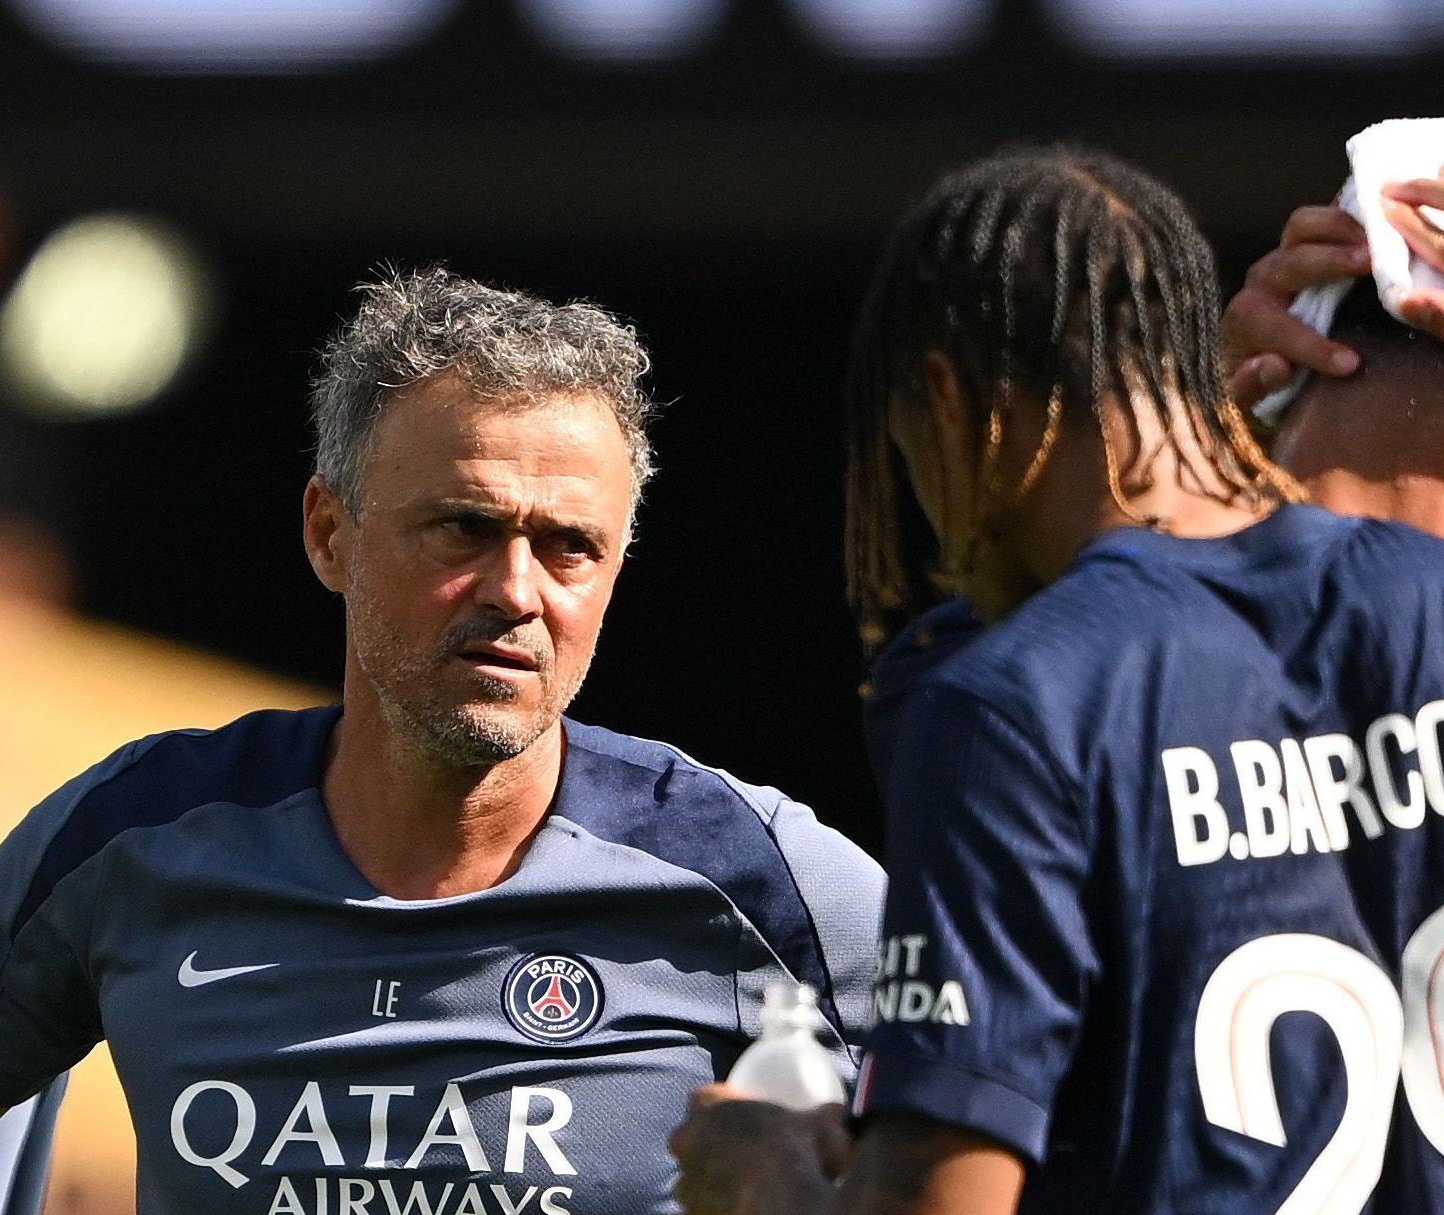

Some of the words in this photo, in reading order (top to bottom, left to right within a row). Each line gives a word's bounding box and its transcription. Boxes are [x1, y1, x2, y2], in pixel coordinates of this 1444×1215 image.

[527, 960, 585, 984] PARIS
[372, 979, 401, 1018] LE
[170, 1080, 578, 1189] QATAR
